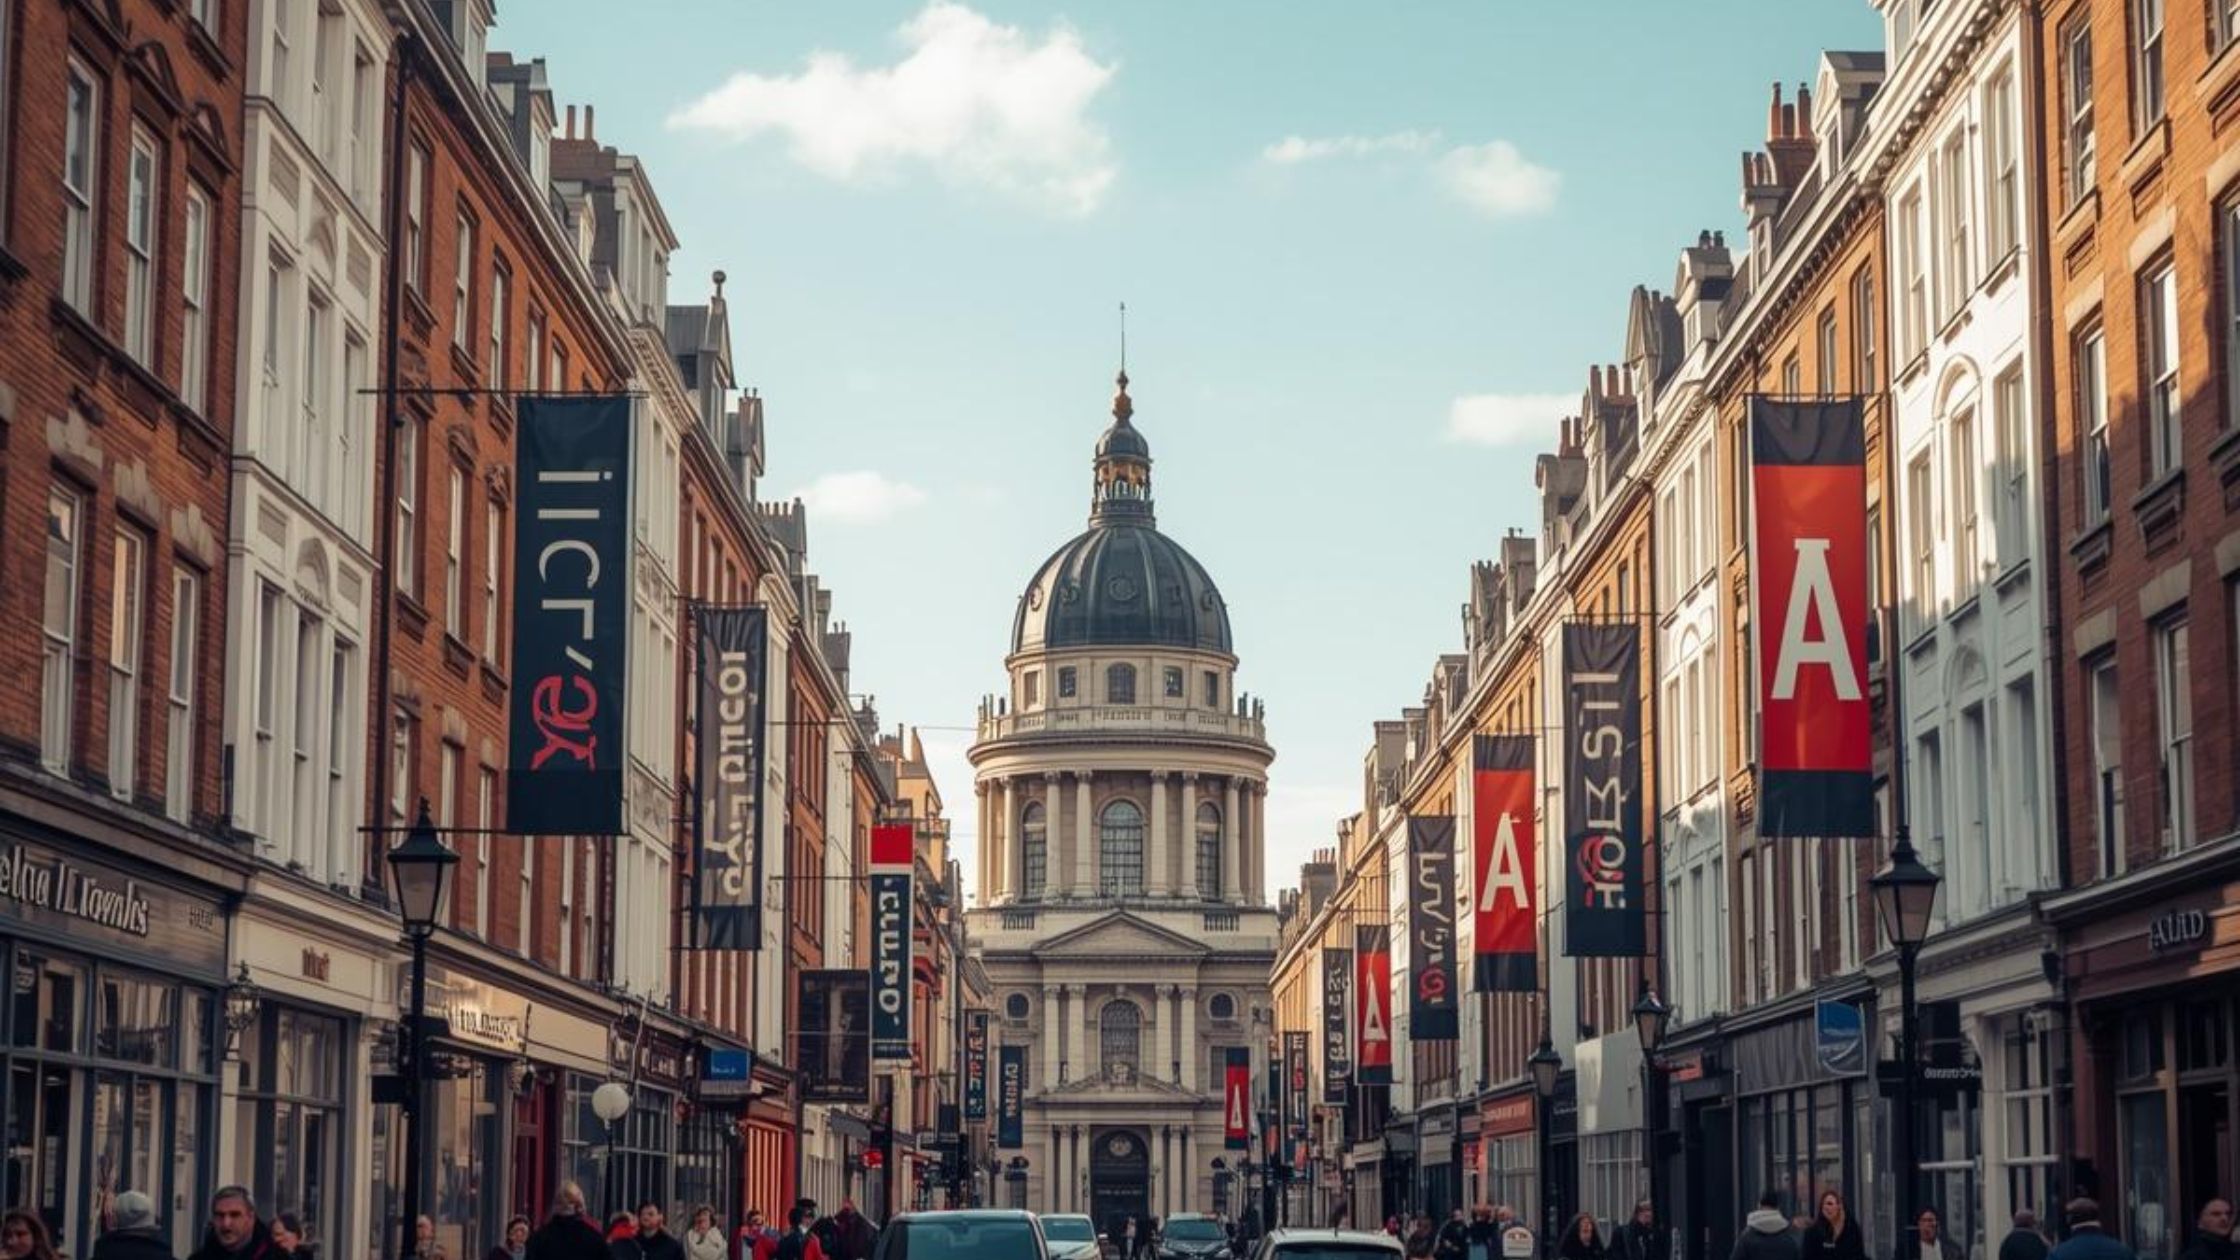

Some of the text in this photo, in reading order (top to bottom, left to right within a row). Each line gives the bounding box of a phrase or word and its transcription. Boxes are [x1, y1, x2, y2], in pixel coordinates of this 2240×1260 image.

[1771, 538, 1862, 700] A
[1480, 812, 1530, 912] A
[1363, 967, 1388, 1041] A
